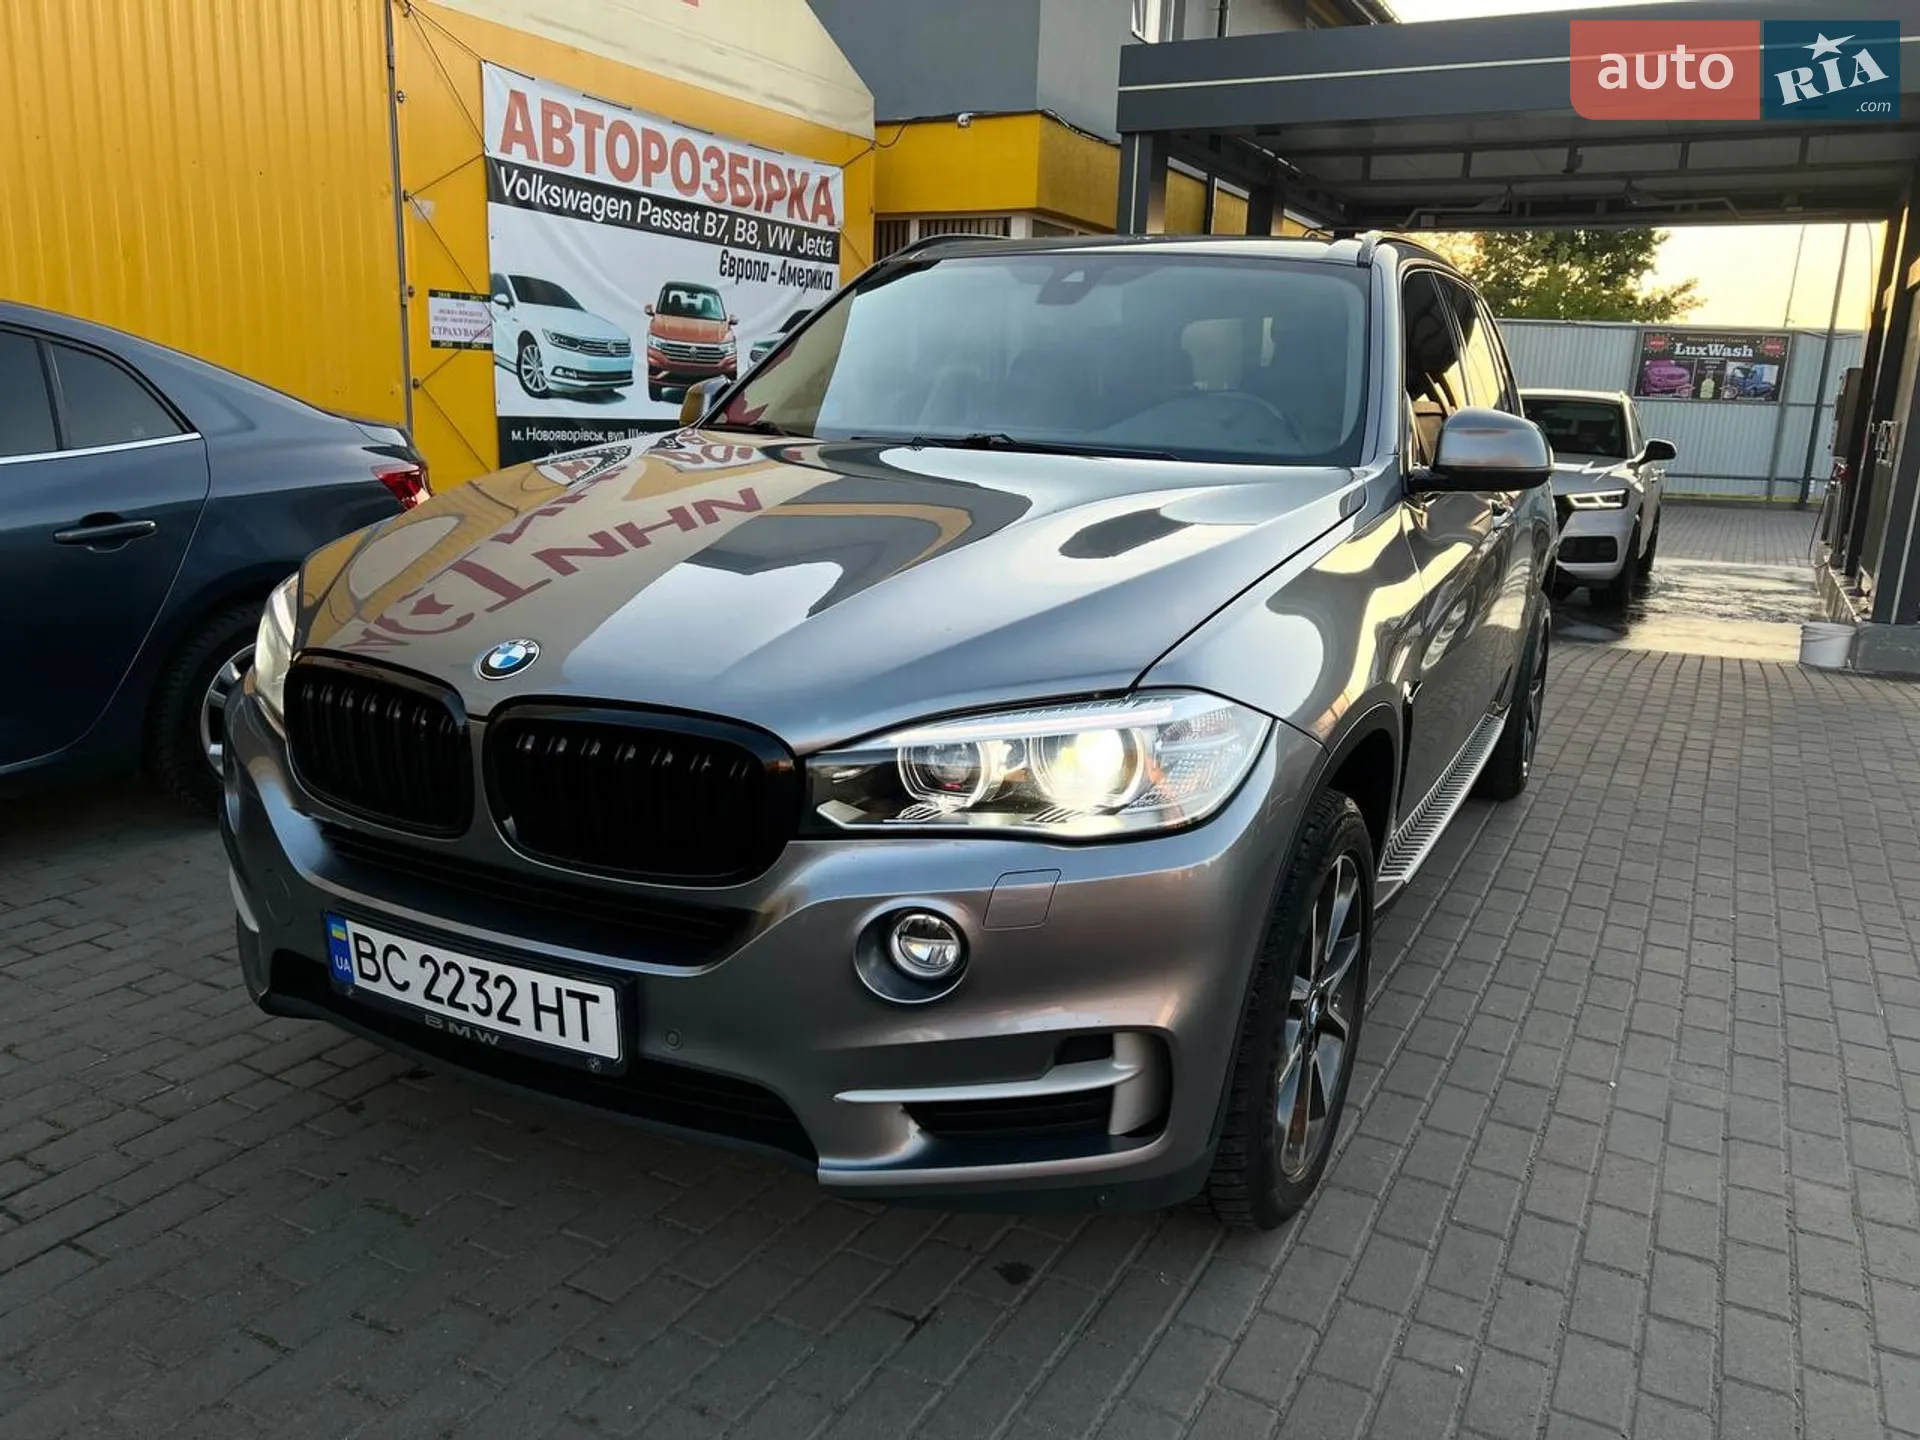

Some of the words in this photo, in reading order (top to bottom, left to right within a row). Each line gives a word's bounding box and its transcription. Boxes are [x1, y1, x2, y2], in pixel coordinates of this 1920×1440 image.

[500, 90, 835, 226] АВТОРОЗБІРКА
[500, 166, 631, 221] Volkswagen
[637, 198, 700, 234] Passat
[703, 211, 729, 244] B7,
[734, 218, 761, 250] B8,
[767, 224, 795, 252] VW
[797, 231, 833, 258] Jetta
[1673, 342, 1754, 359] LuxWash
[335, 955, 352, 973] UA
[353, 932, 411, 992] BC
[419, 954, 521, 1027] 2232
[531, 981, 600, 1043] HT
[424, 1014, 500, 1045] BMW
